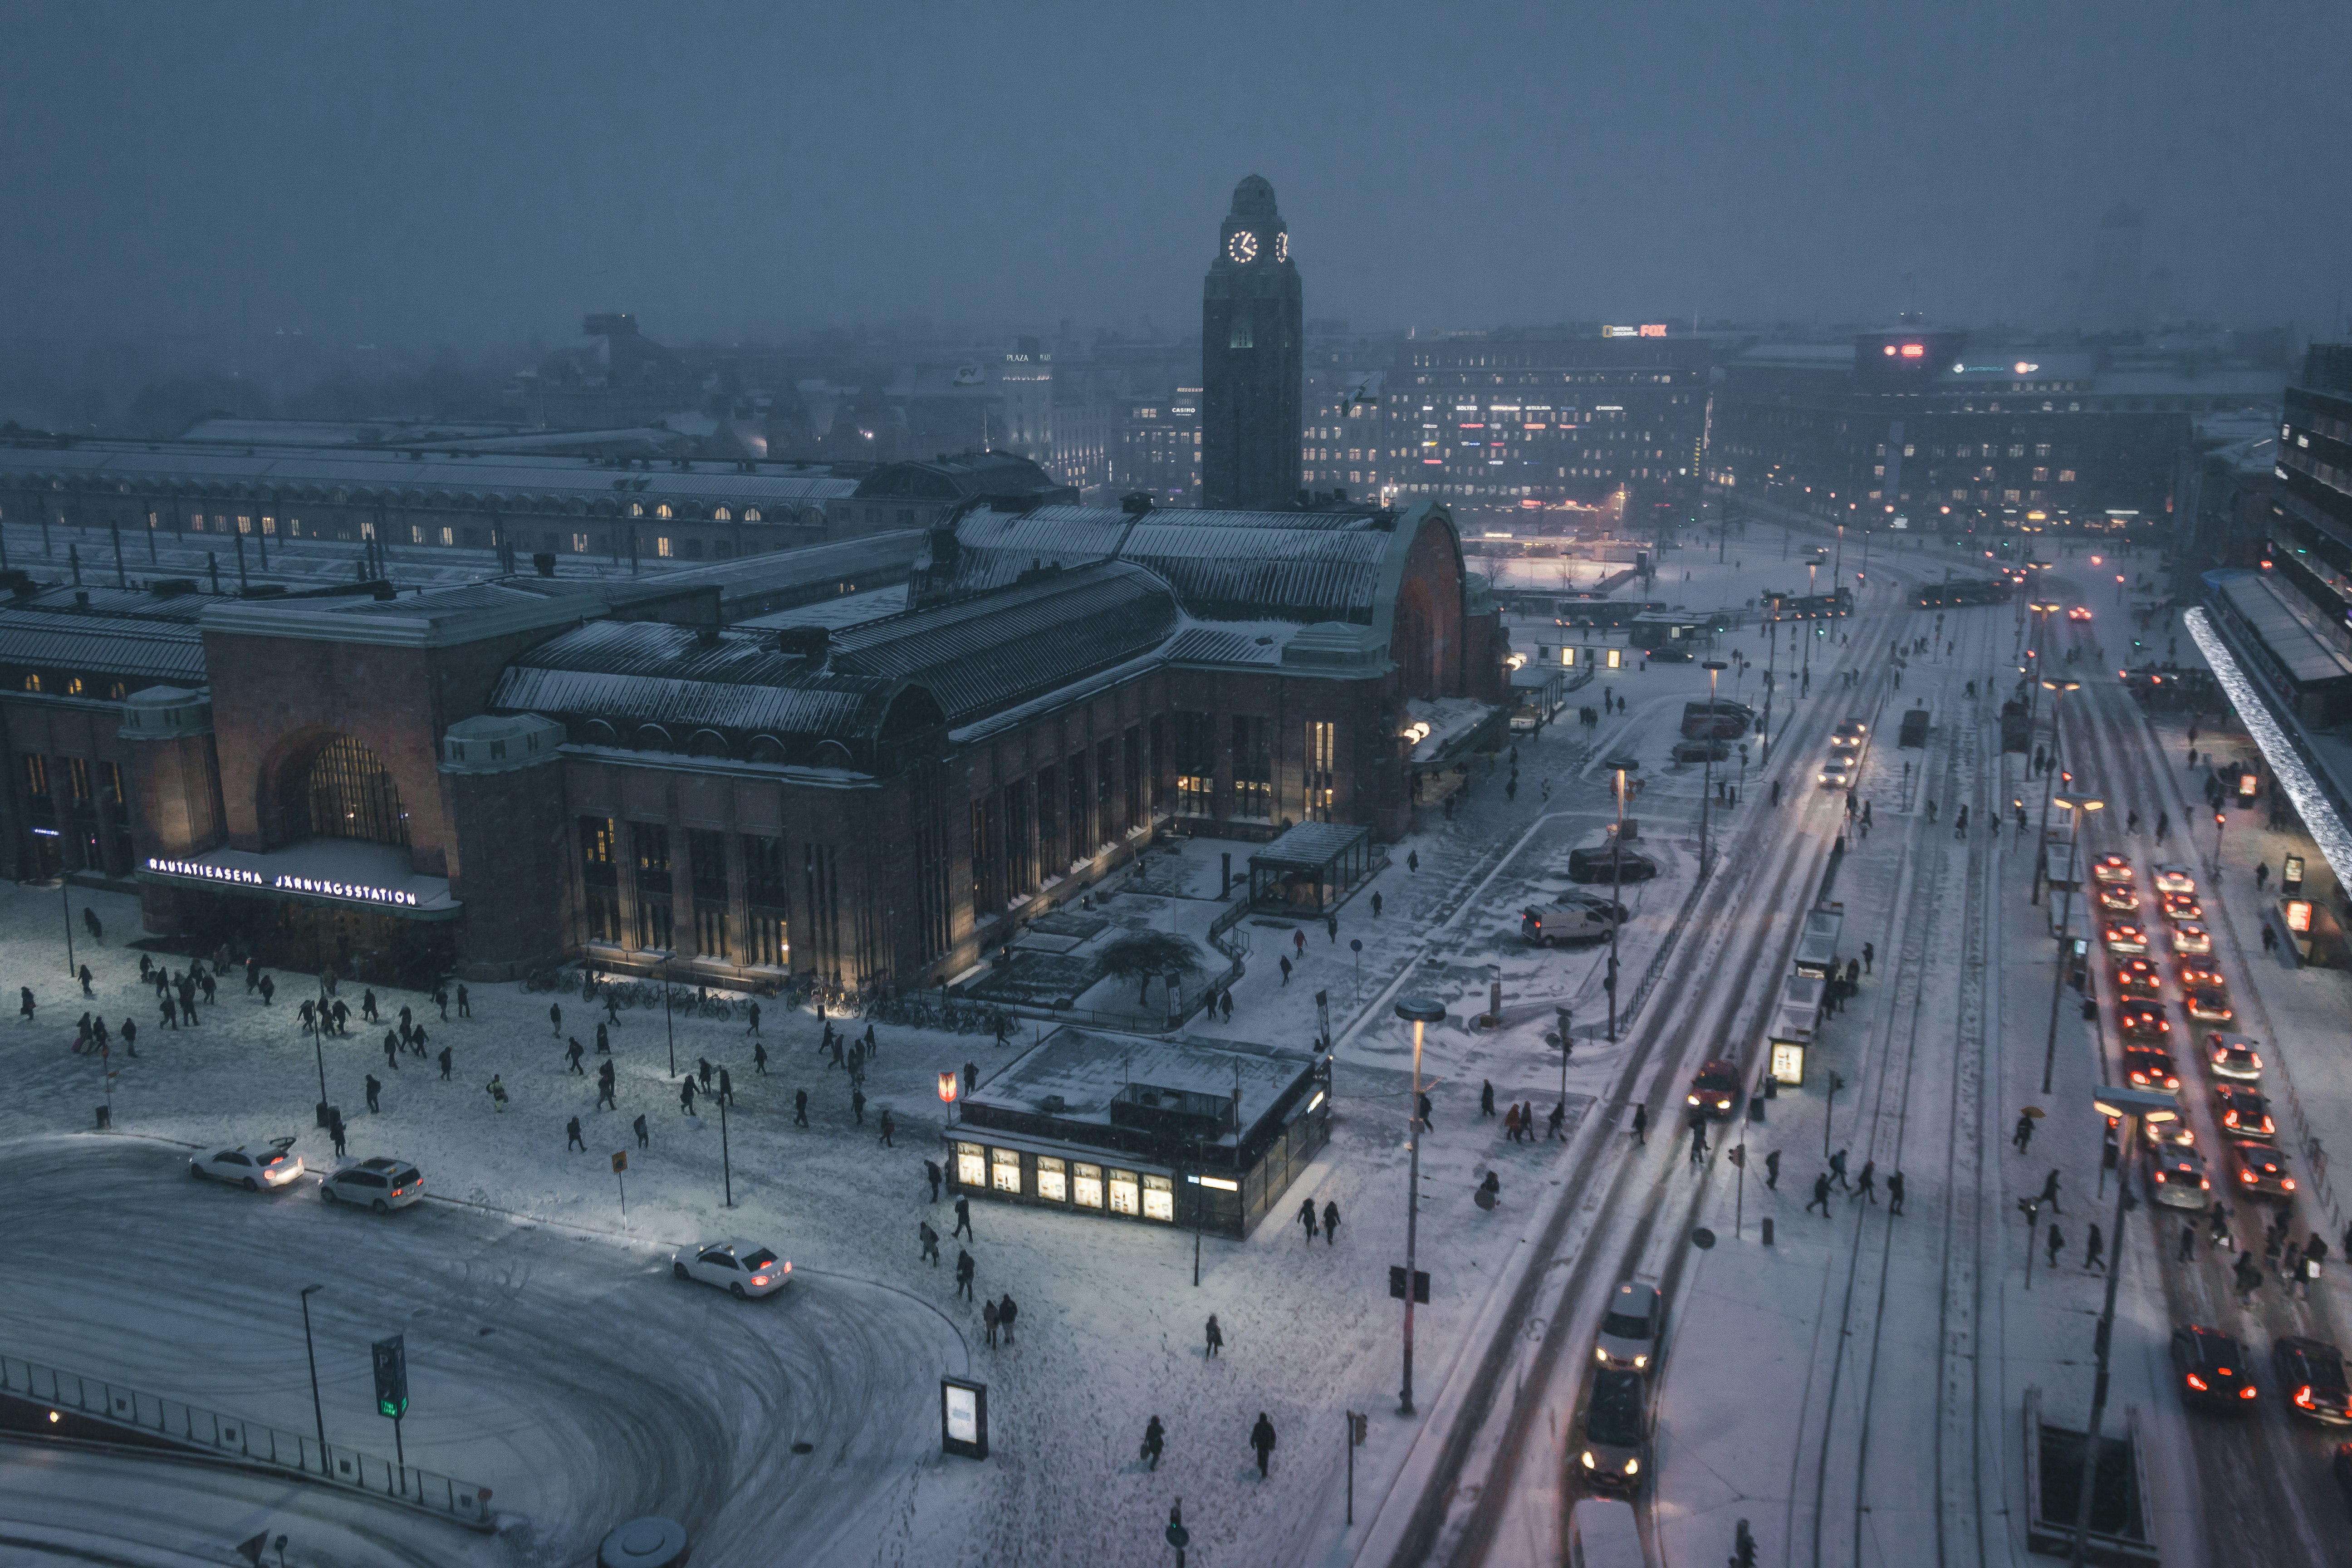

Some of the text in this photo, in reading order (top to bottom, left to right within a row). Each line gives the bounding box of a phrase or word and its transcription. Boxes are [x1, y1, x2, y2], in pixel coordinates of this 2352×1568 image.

[1640, 324, 1667, 337] FOX
[149, 858, 416, 905] RAUTATIEASEMA JÄRNVÄGSSTATION
[379, 1353, 389, 1368] P
